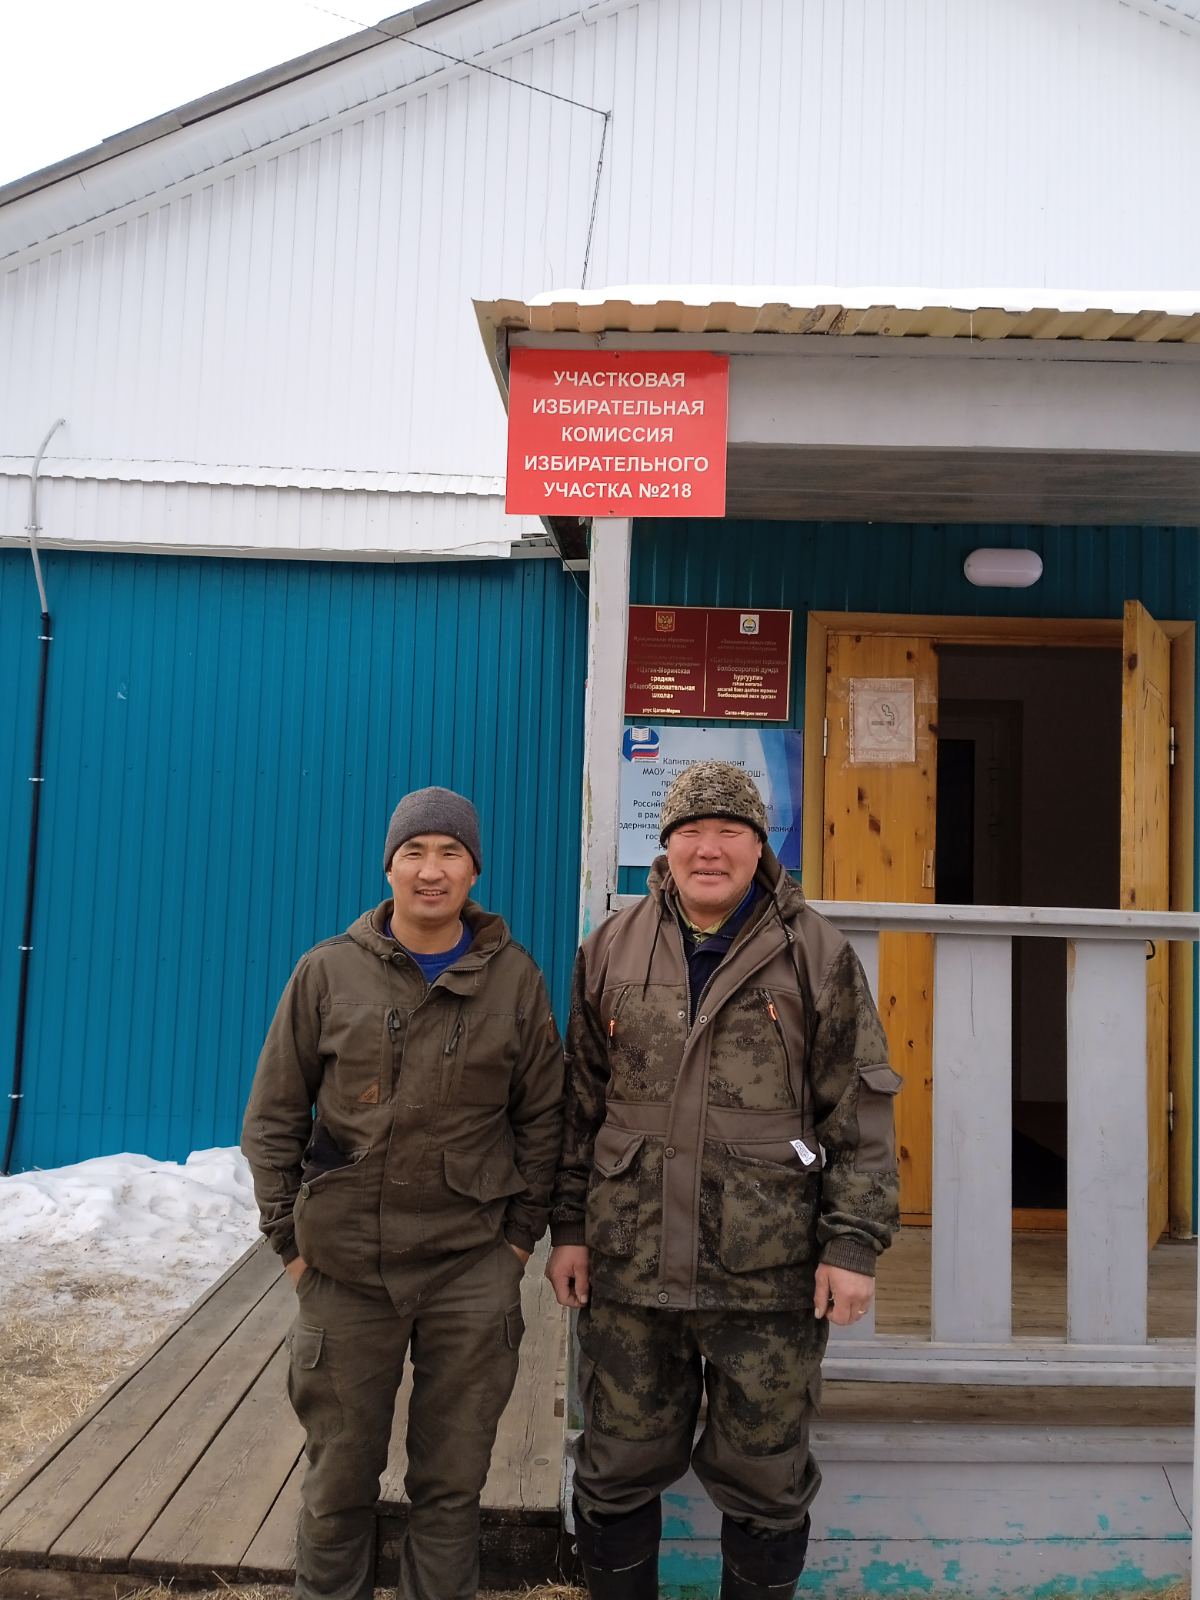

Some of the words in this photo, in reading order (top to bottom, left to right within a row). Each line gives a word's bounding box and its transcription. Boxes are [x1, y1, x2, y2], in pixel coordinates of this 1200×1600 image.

[553, 371, 686, 388] УЧАСТКОВАЯ
[532, 398, 705, 416] ИЗБИРАТЕЛЬНАЯ
[561, 426, 673, 443] КОМИССИЯ
[524, 455, 709, 472] ИЗБИРАТЕЛЬНОГО
[543, 481, 633, 498] УЧАСТКА
[638, 483, 692, 498] №218
[642, 768, 665, 776] МАОУ
